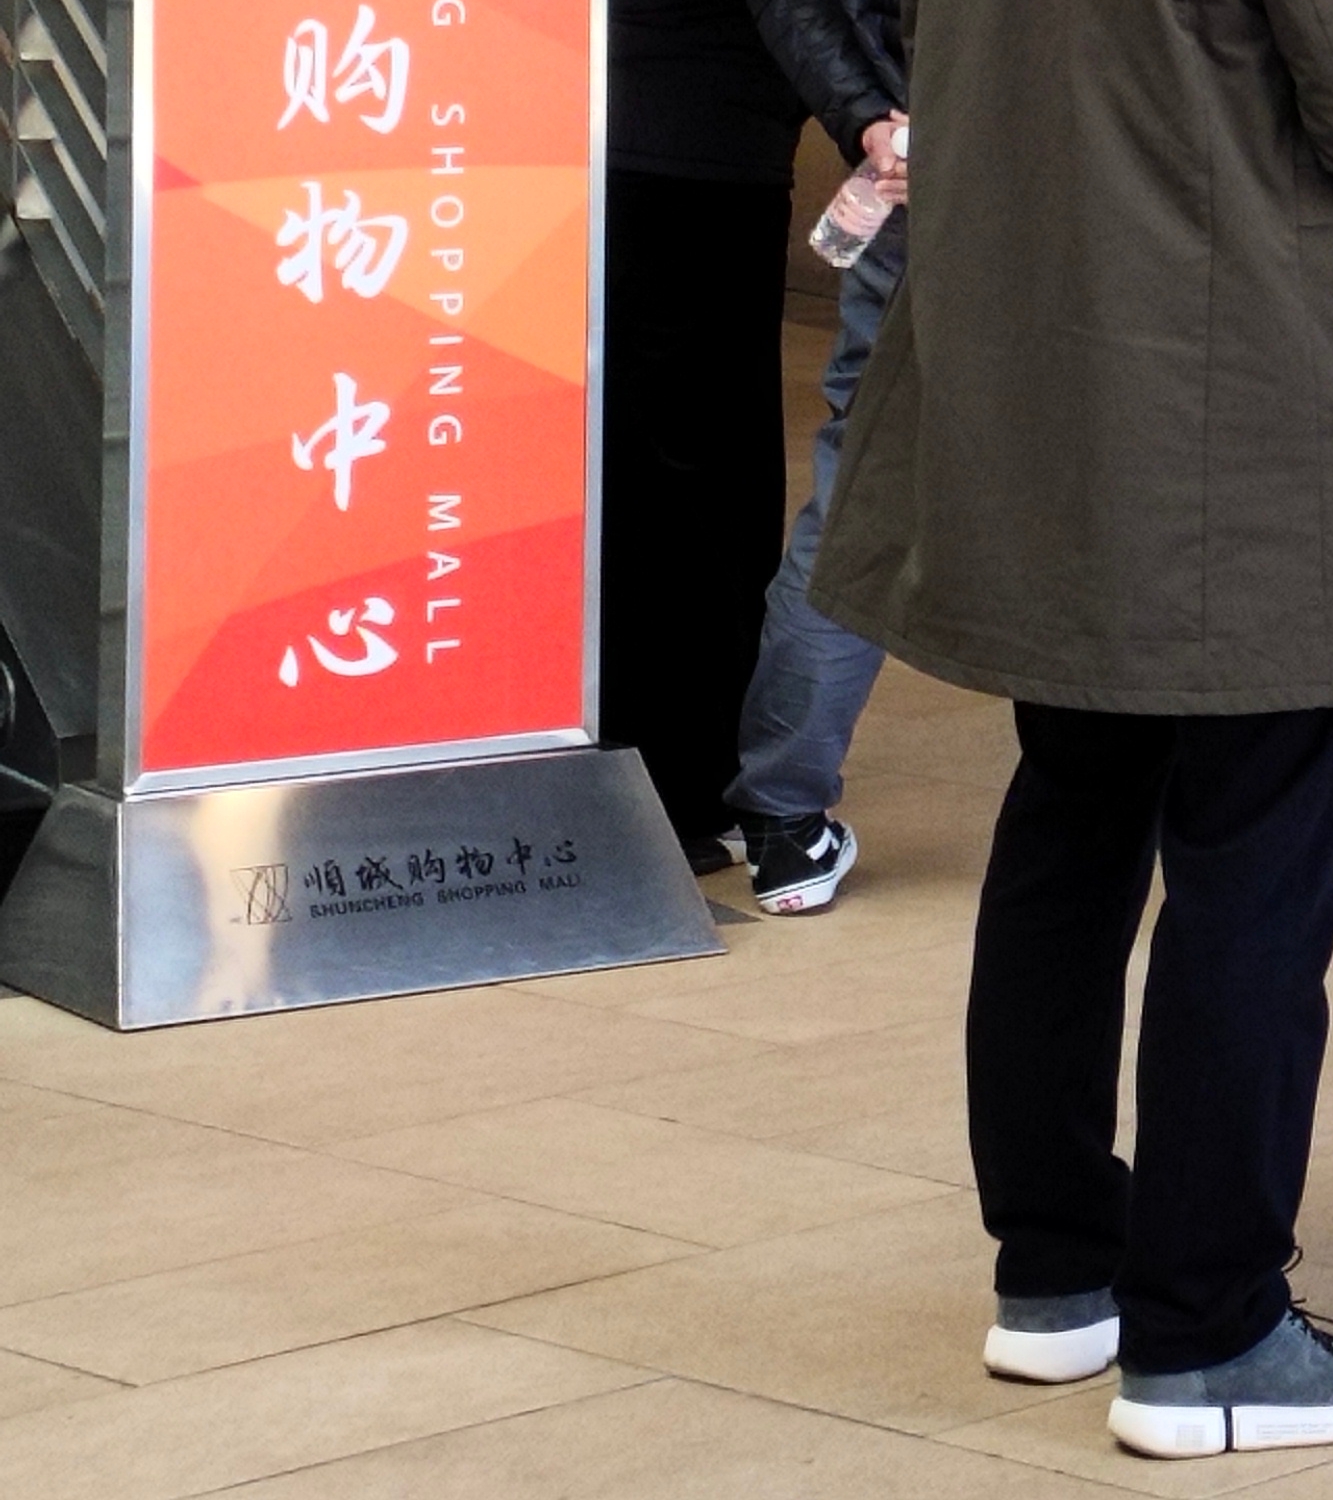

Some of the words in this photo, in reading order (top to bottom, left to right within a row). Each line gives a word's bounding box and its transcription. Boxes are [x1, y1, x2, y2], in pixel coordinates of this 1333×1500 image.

[428, 103, 466, 447] SHOPPING
[426, 493, 462, 665] MALL
[309, 890, 425, 919] SHUNCHENG
[436, 880, 527, 904] SHOPPING
